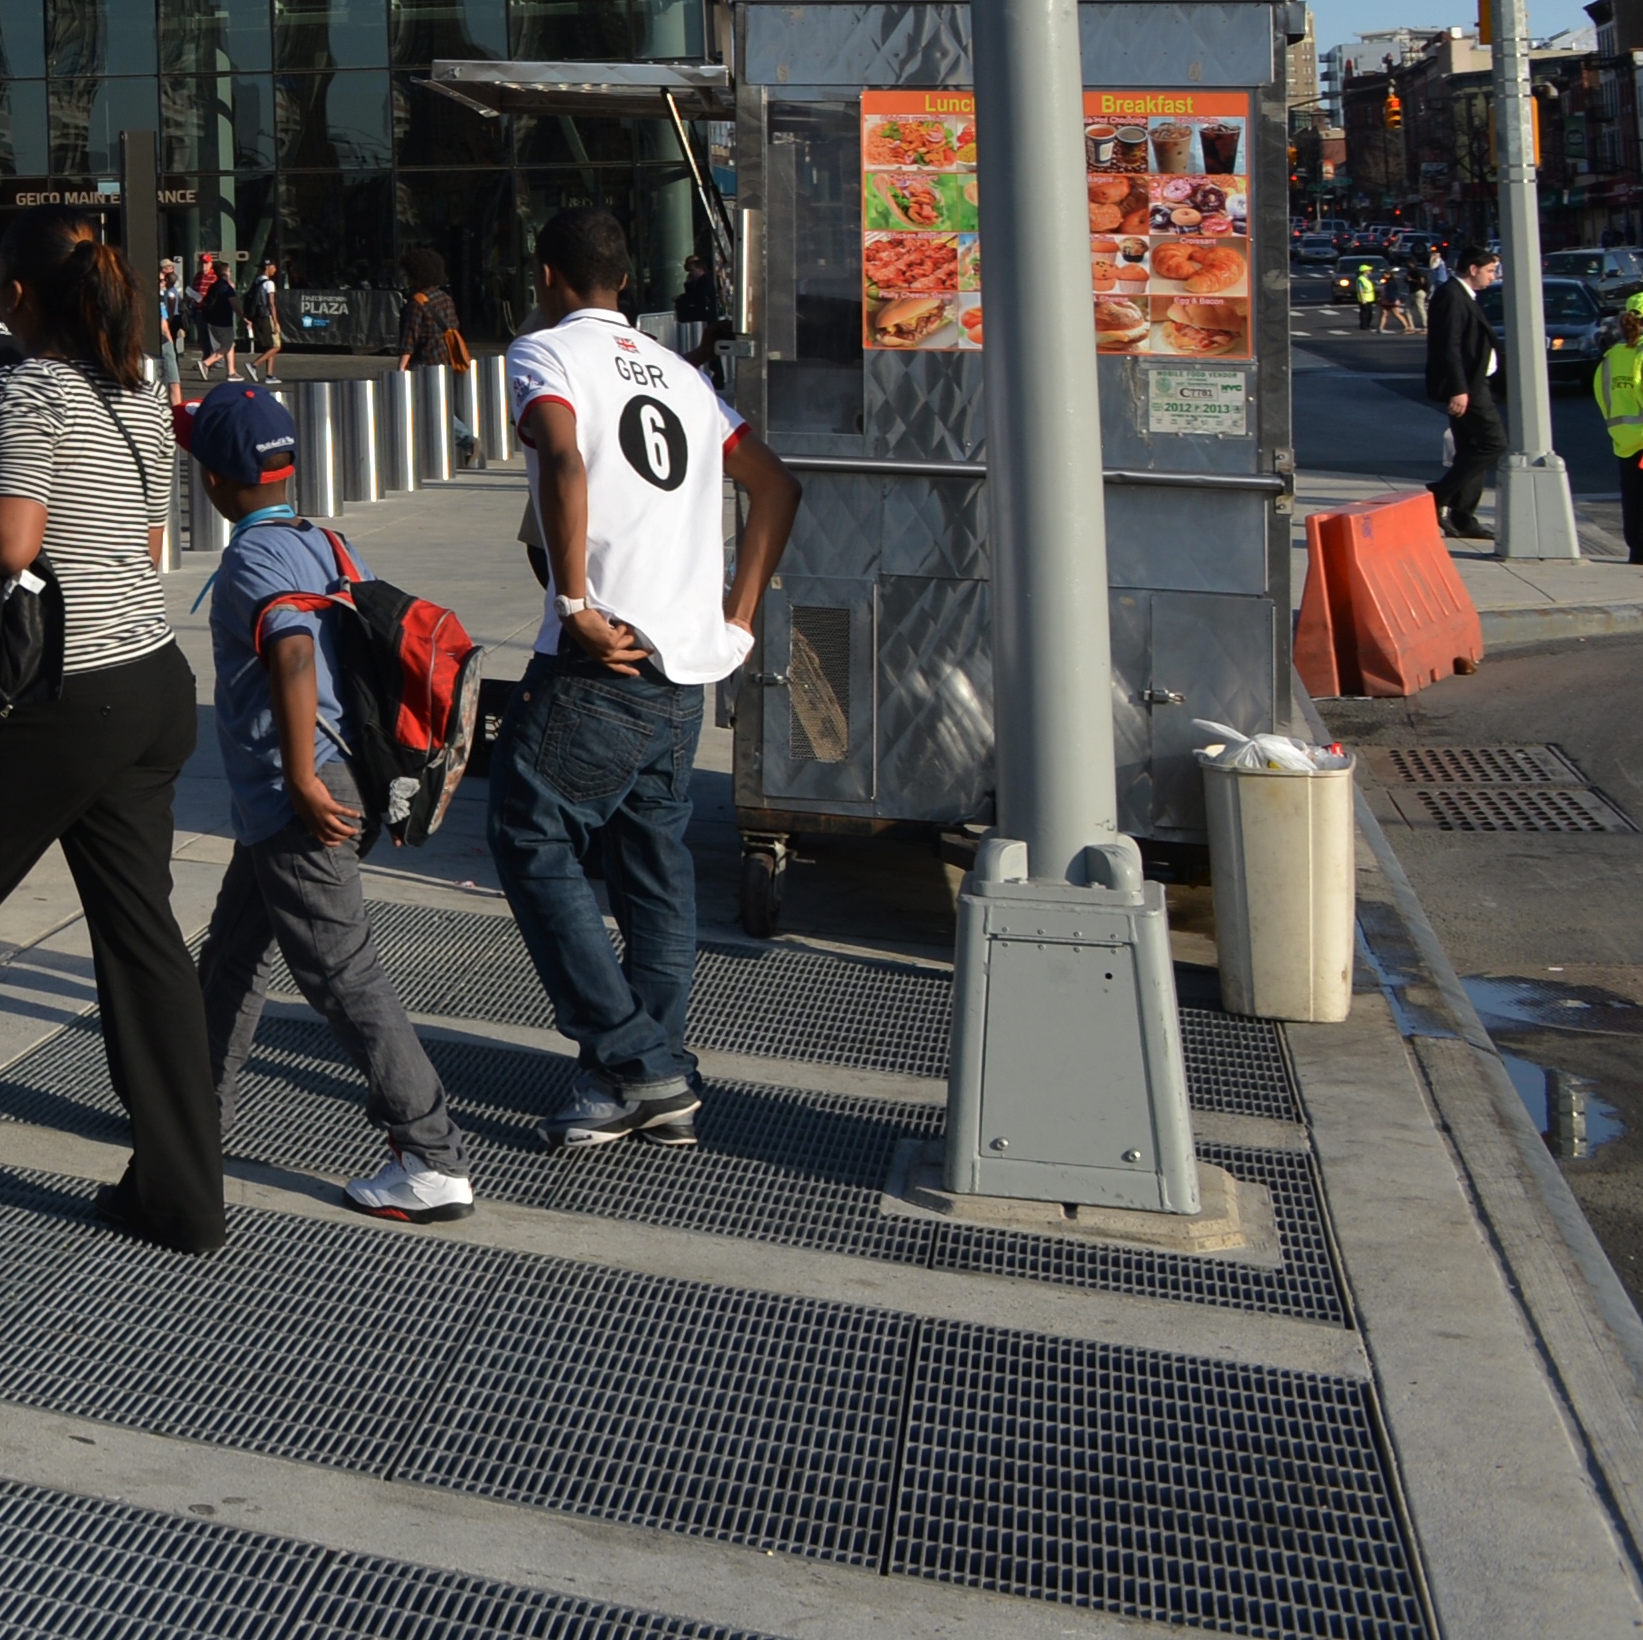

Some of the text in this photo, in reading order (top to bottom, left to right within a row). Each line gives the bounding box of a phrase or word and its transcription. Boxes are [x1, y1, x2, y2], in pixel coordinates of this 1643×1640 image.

[924, 95, 975, 111] Lunc
[1101, 95, 1194, 113] Breakfast
[15, 192, 60, 206] GEICO
[65, 191, 106, 205] MAIN
[300, 301, 349, 315] PLAZA
[1173, 296, 1190, 305] Egg
[1199, 297, 1224, 305] Bacon
[614, 355, 670, 390] GBR
[1220, 384, 1243, 392] NYC
[1164, 402, 1192, 412] 2012
[1203, 404, 1231, 414] 2013
[639, 403, 671, 481] 6
